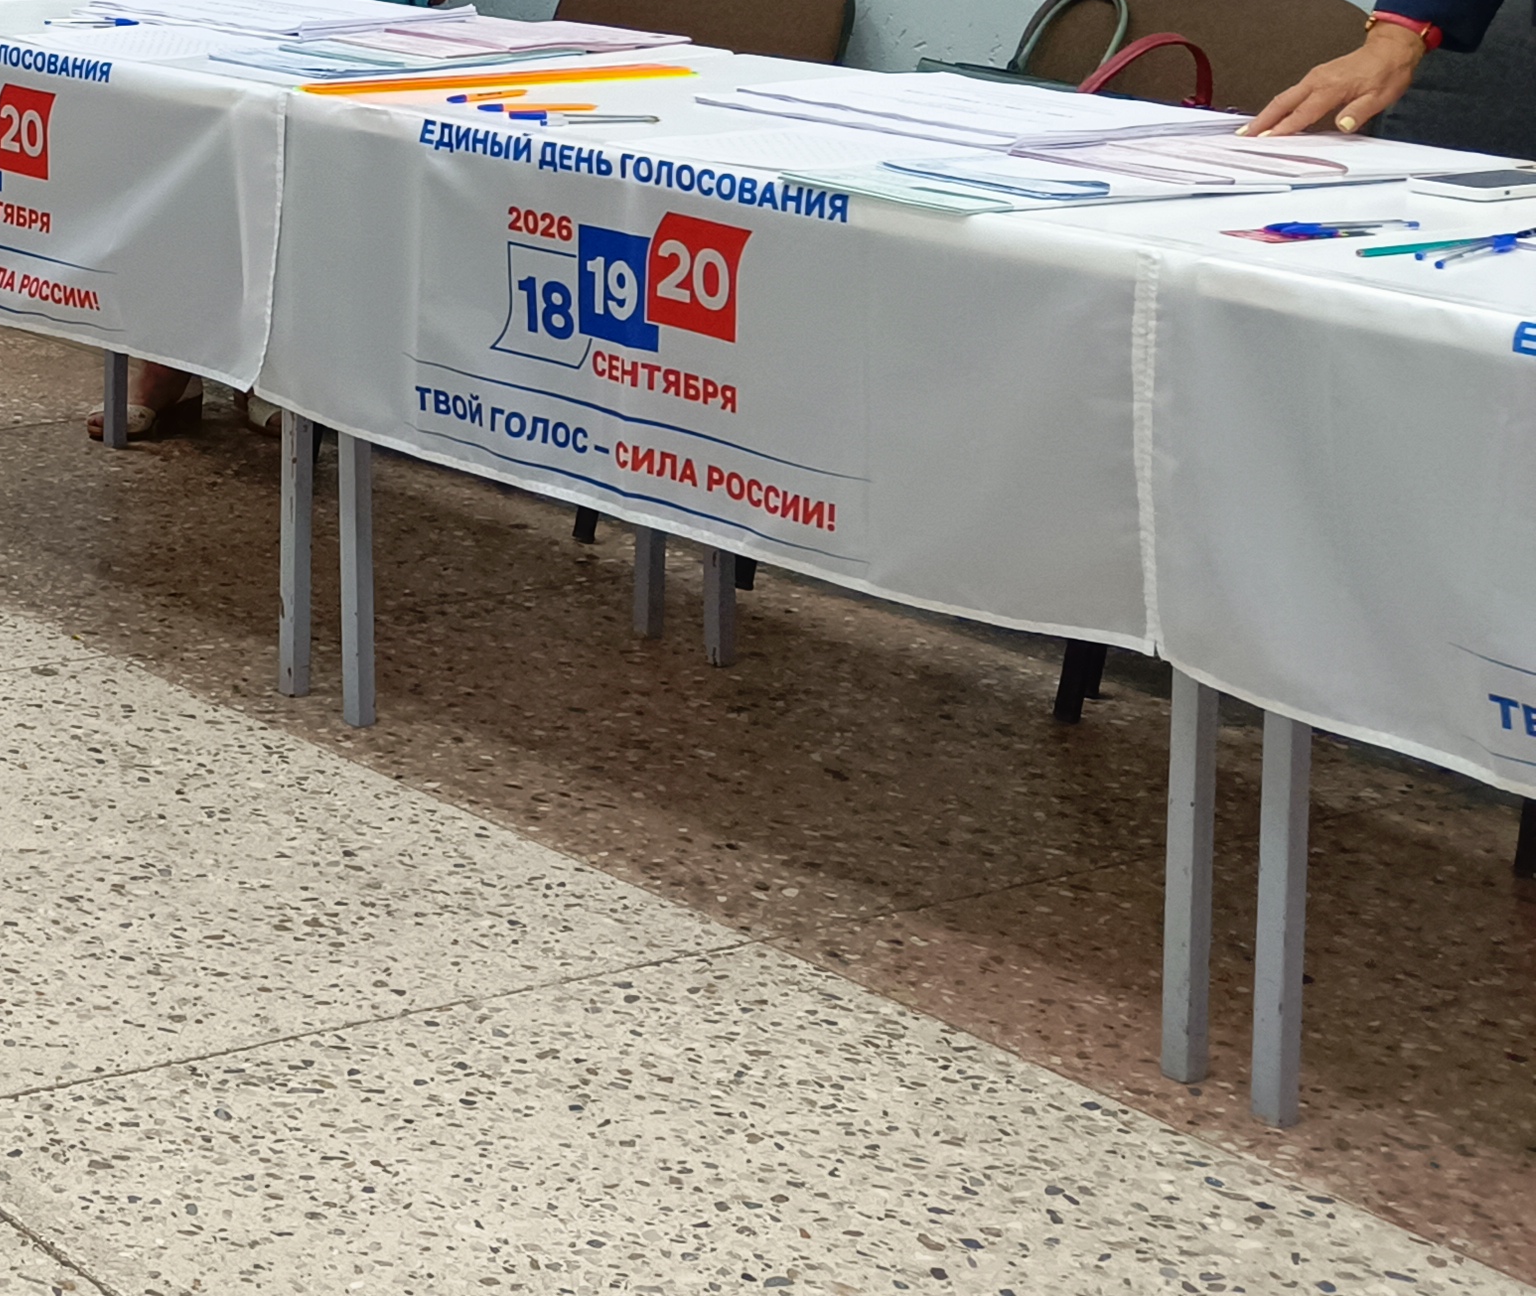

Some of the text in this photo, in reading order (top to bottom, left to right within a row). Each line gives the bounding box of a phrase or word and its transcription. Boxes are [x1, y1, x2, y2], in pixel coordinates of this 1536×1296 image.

[0, 103, 44, 158] 20
[419, 119, 850, 224] ЕДИНЫЙ ДЕНЬ ГОЛОСОВАНИЯ
[507, 206, 573, 242] 2026
[18, 275, 101, 311] РОССИИ!
[517, 239, 730, 340] 18 19 20
[592, 350, 738, 414] СЕНТЯБРЯ
[415, 385, 483, 429] ТВОЙ
[490, 407, 589, 455] ГОЛОС
[614, 440, 699, 488] СИЛА
[707, 465, 837, 533] РОССИИ!
